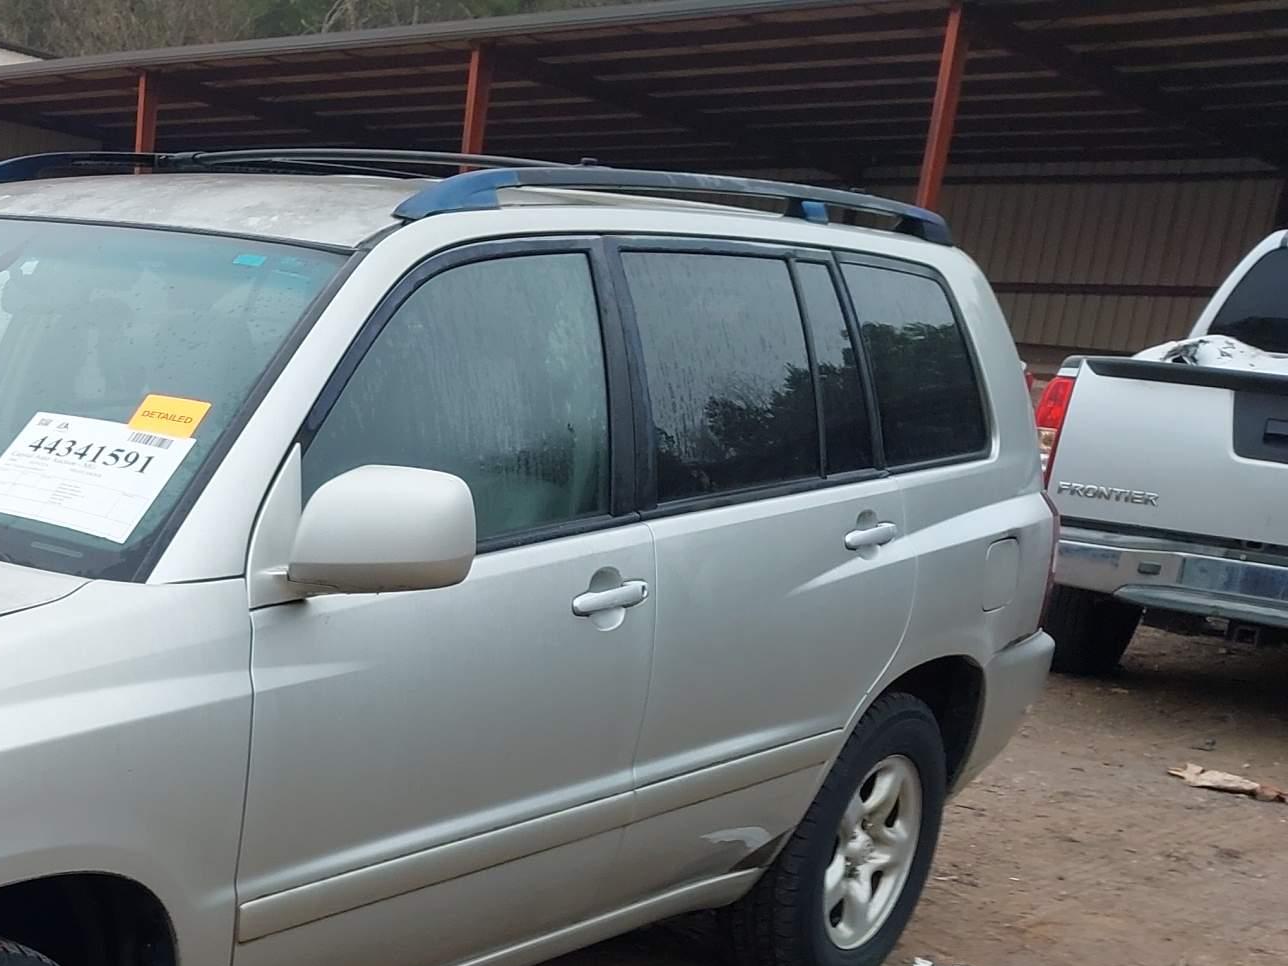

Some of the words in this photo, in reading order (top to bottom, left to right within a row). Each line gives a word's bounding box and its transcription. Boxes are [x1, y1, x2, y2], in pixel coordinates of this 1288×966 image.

[141, 410, 193, 424] DETAILED
[28, 435, 155, 474] 44341591
[1056, 480, 1160, 506] FRONTIER
